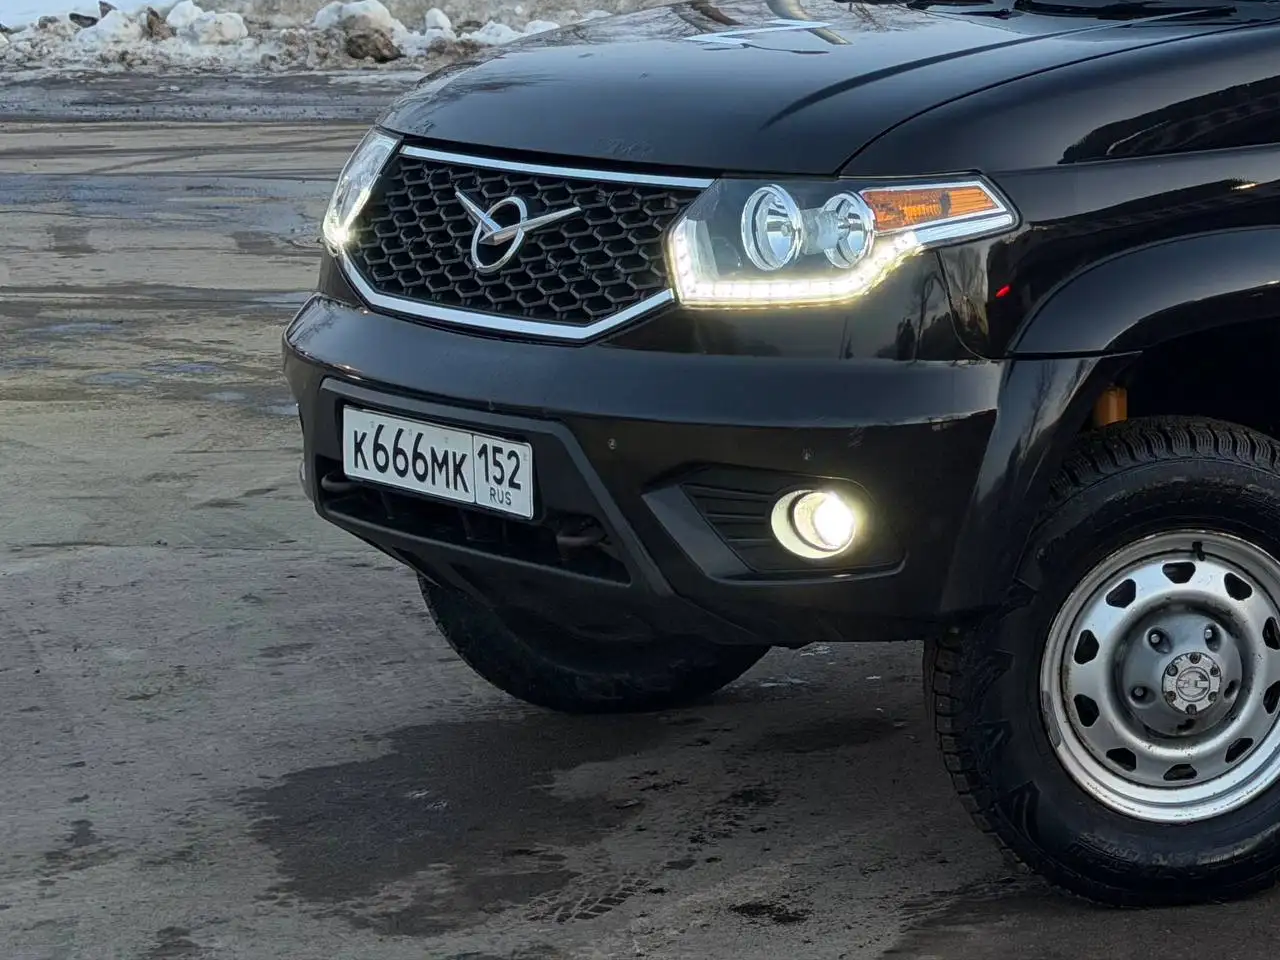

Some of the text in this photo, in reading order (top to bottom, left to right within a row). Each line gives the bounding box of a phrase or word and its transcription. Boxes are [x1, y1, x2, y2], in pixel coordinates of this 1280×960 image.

[353, 424, 521, 493] К666МК 152
[489, 487, 512, 506] RUS
